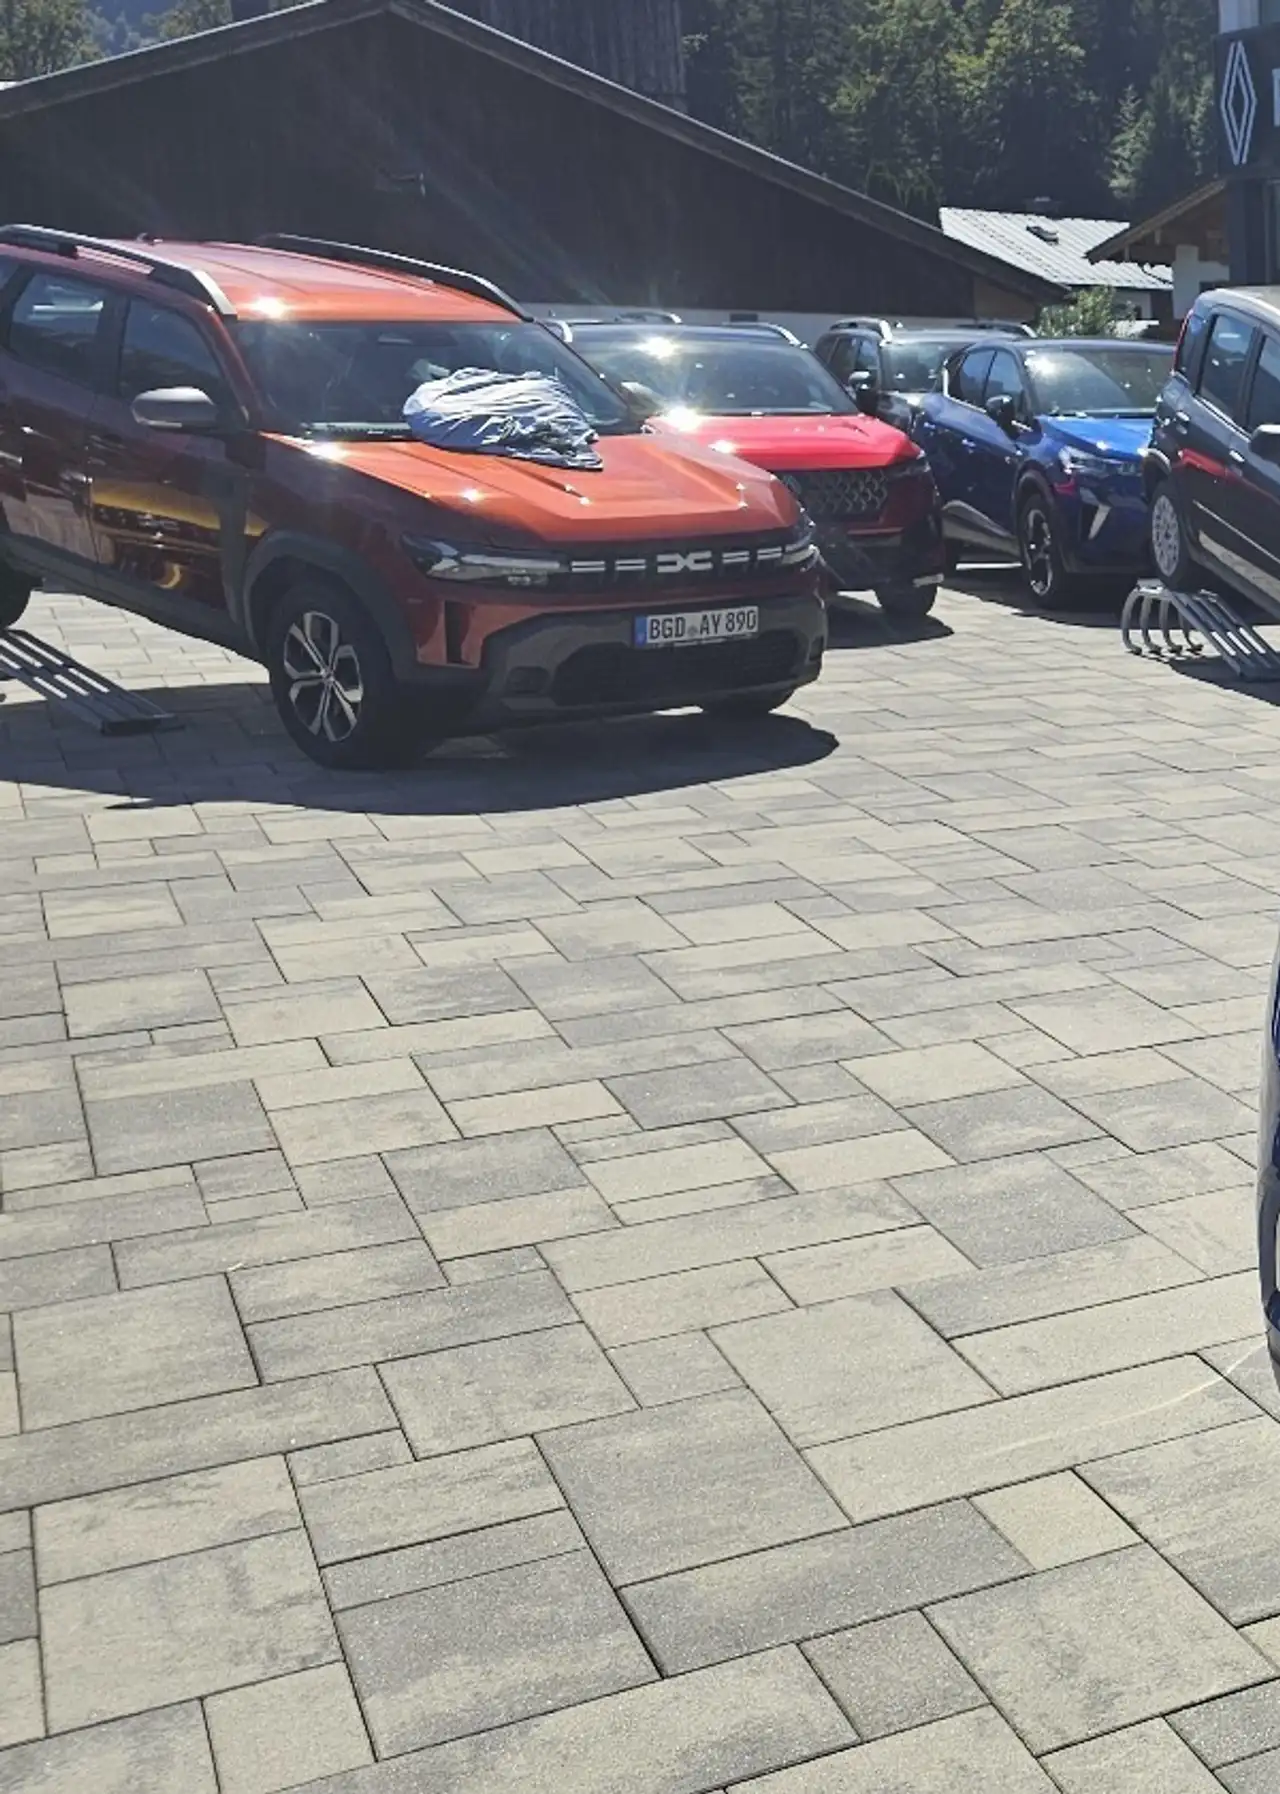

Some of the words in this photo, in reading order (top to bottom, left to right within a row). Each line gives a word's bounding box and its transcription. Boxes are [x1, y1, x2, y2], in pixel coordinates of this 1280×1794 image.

[650, 616, 686, 639] BGD
[700, 614, 721, 635] AY
[725, 610, 756, 632] 890
